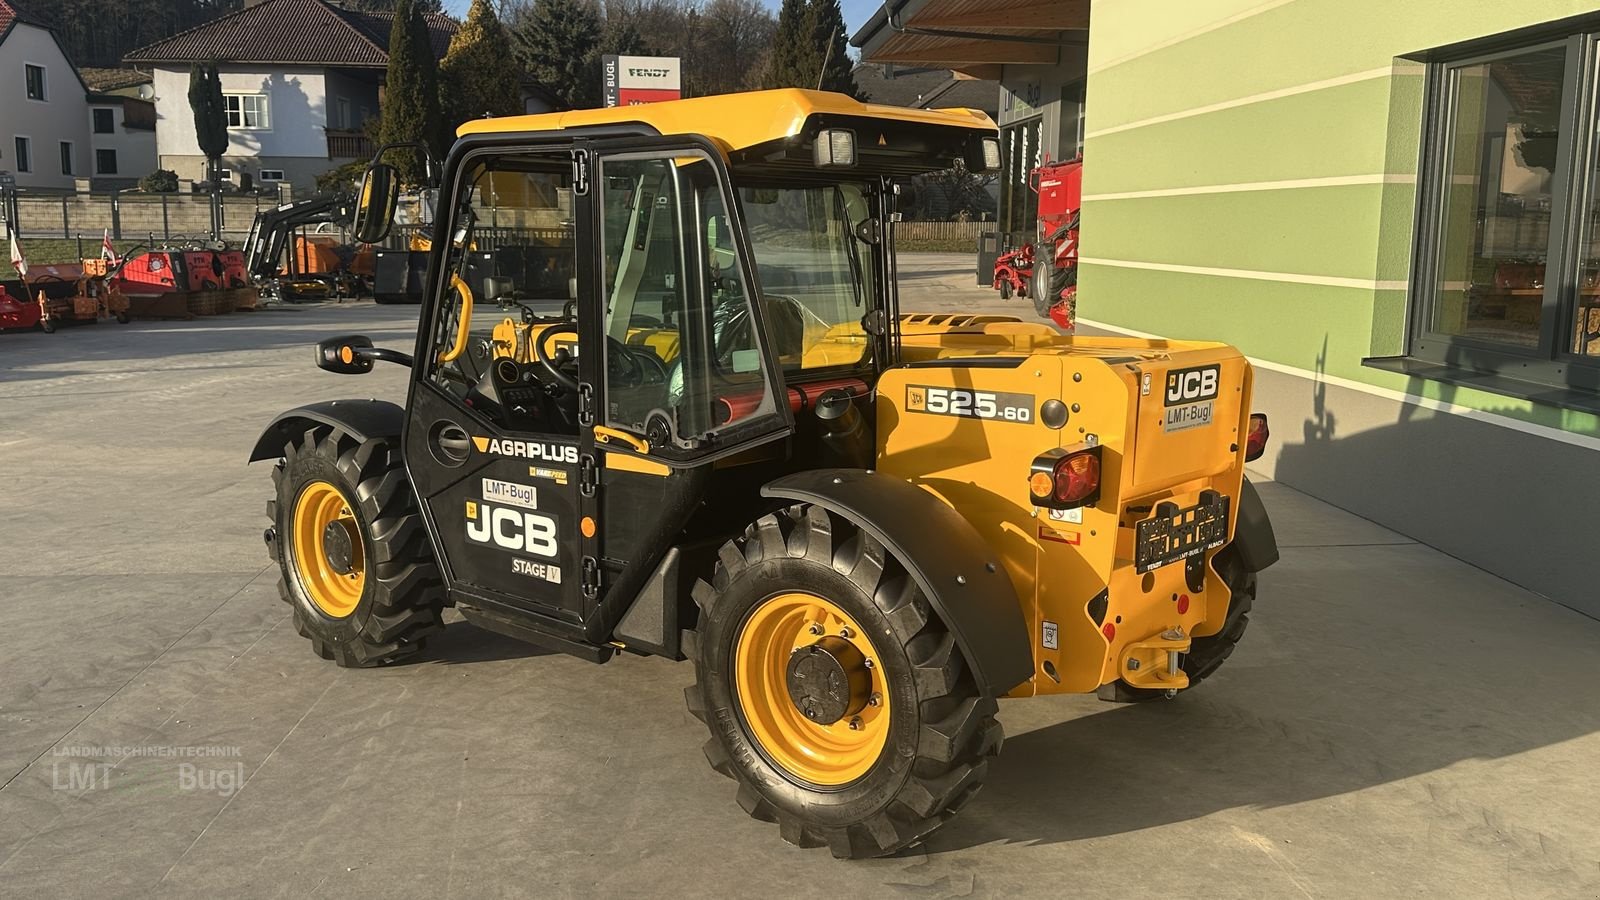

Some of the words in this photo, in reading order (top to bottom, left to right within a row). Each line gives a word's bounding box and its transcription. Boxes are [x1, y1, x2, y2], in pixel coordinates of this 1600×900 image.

[607, 60, 615, 87] BUGL
[628, 68, 670, 78] FENDT
[1168, 369, 1217, 402] JCB
[1167, 402, 1212, 425] LMT-Bugl
[488, 438, 579, 464] AGRIPLUS
[486, 481, 533, 503] LMT-Bugl
[466, 504, 558, 558] JCB
[513, 559, 546, 579] STAGE
